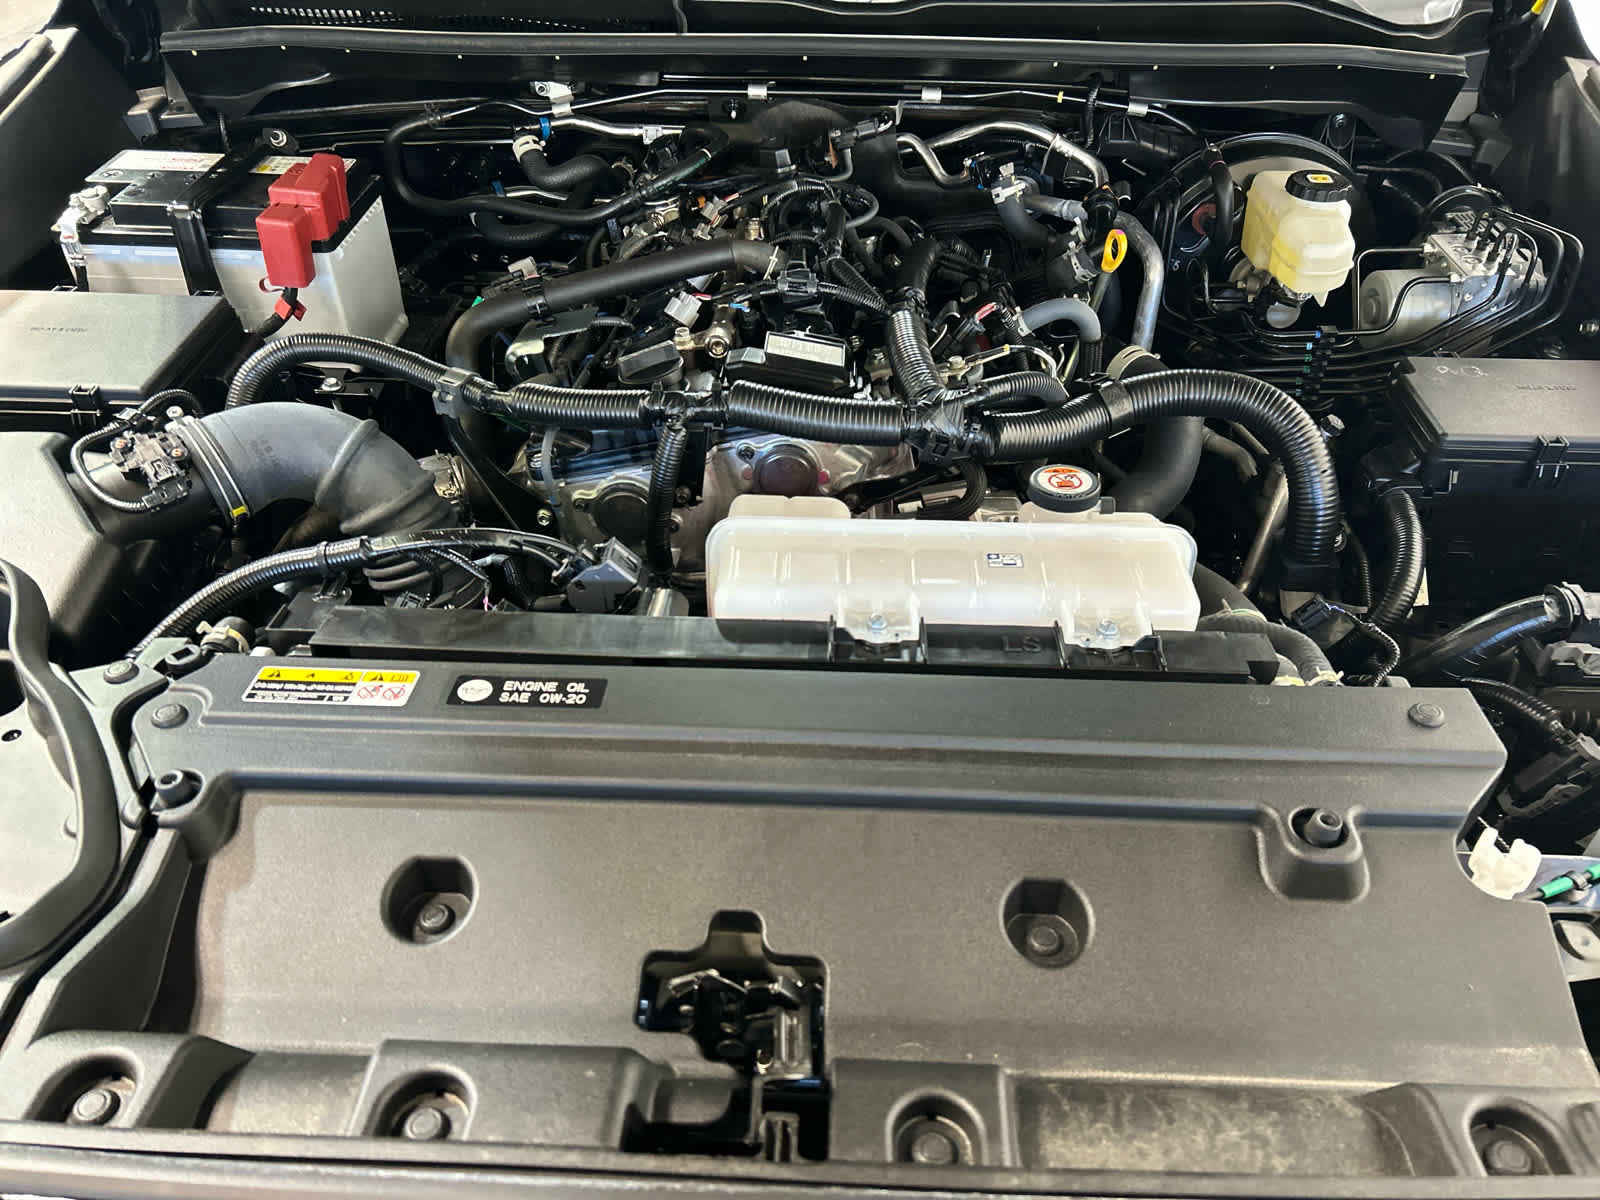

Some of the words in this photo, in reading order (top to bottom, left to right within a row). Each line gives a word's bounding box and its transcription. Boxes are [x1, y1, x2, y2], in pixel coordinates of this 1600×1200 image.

[503, 680, 558, 692] ENGINE
[566, 682, 589, 693] OIL
[499, 692, 531, 703] SAE
